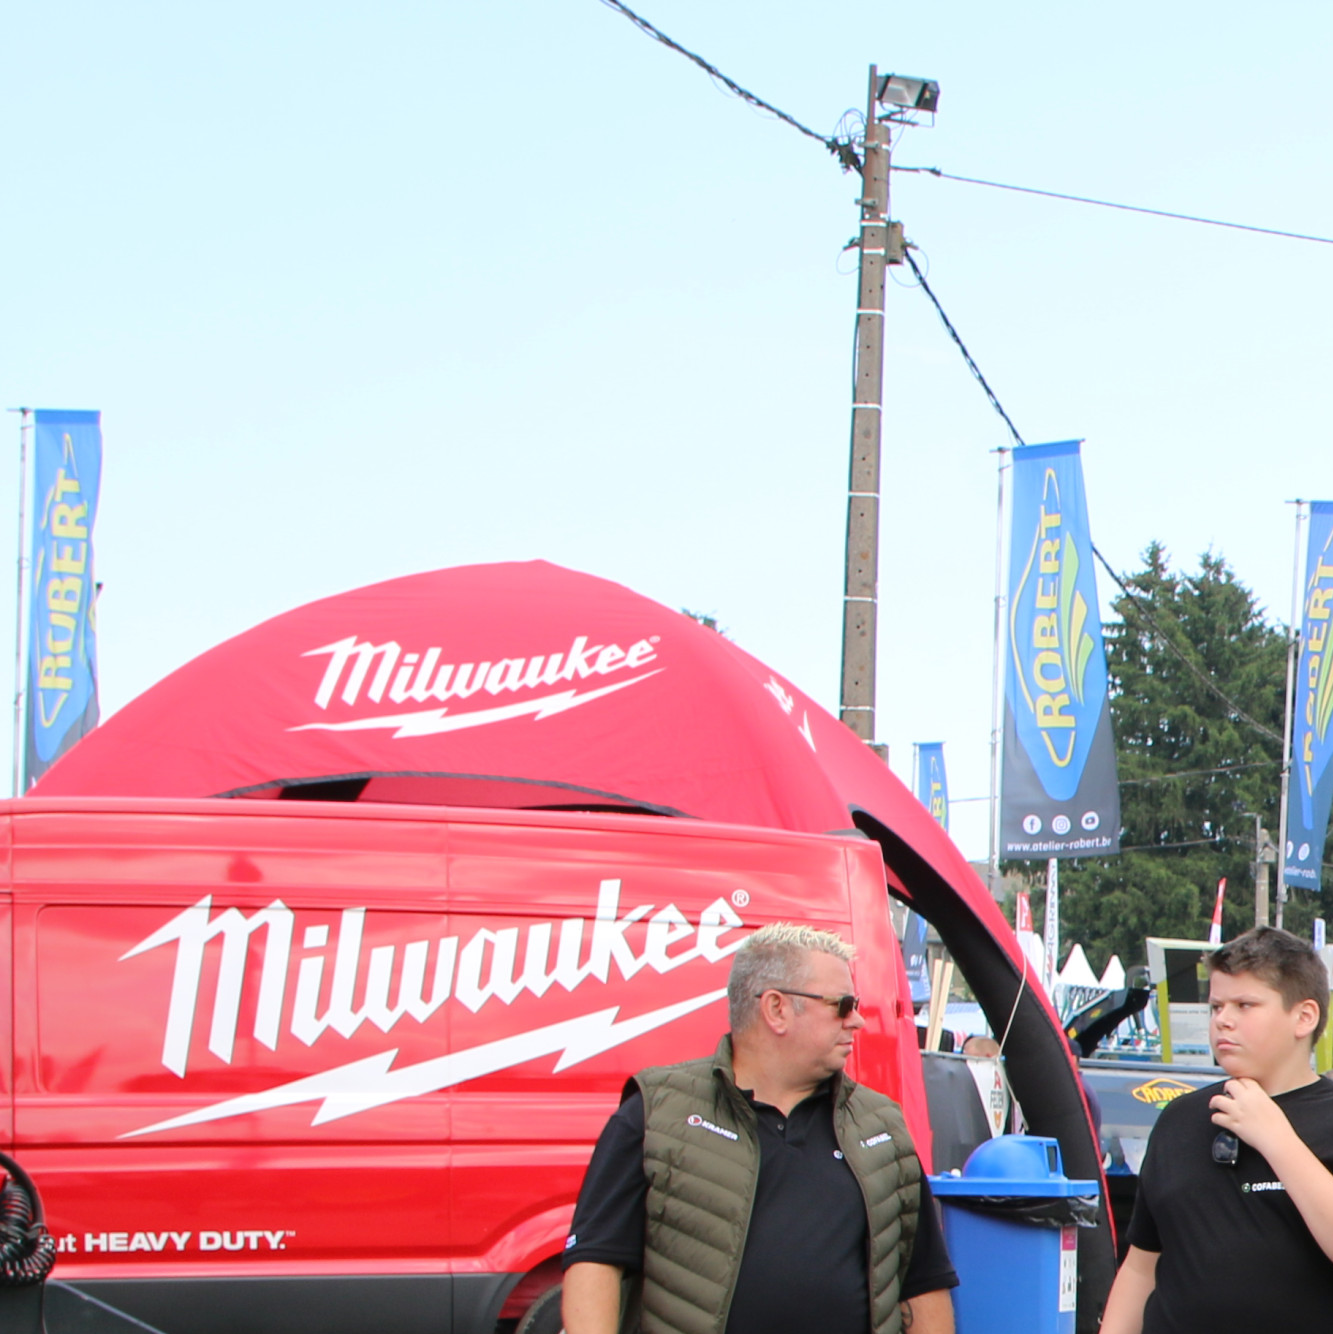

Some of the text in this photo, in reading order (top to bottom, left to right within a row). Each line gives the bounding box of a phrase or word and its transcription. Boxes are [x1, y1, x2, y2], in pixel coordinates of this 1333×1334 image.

[38, 467, 89, 690] ROBERT
[1033, 504, 1076, 728] ROBERT
[300, 635, 657, 710] Milwaukee
[702, 1119, 739, 1141] KRAMER
[85, 1231, 192, 1252] HEAVY
